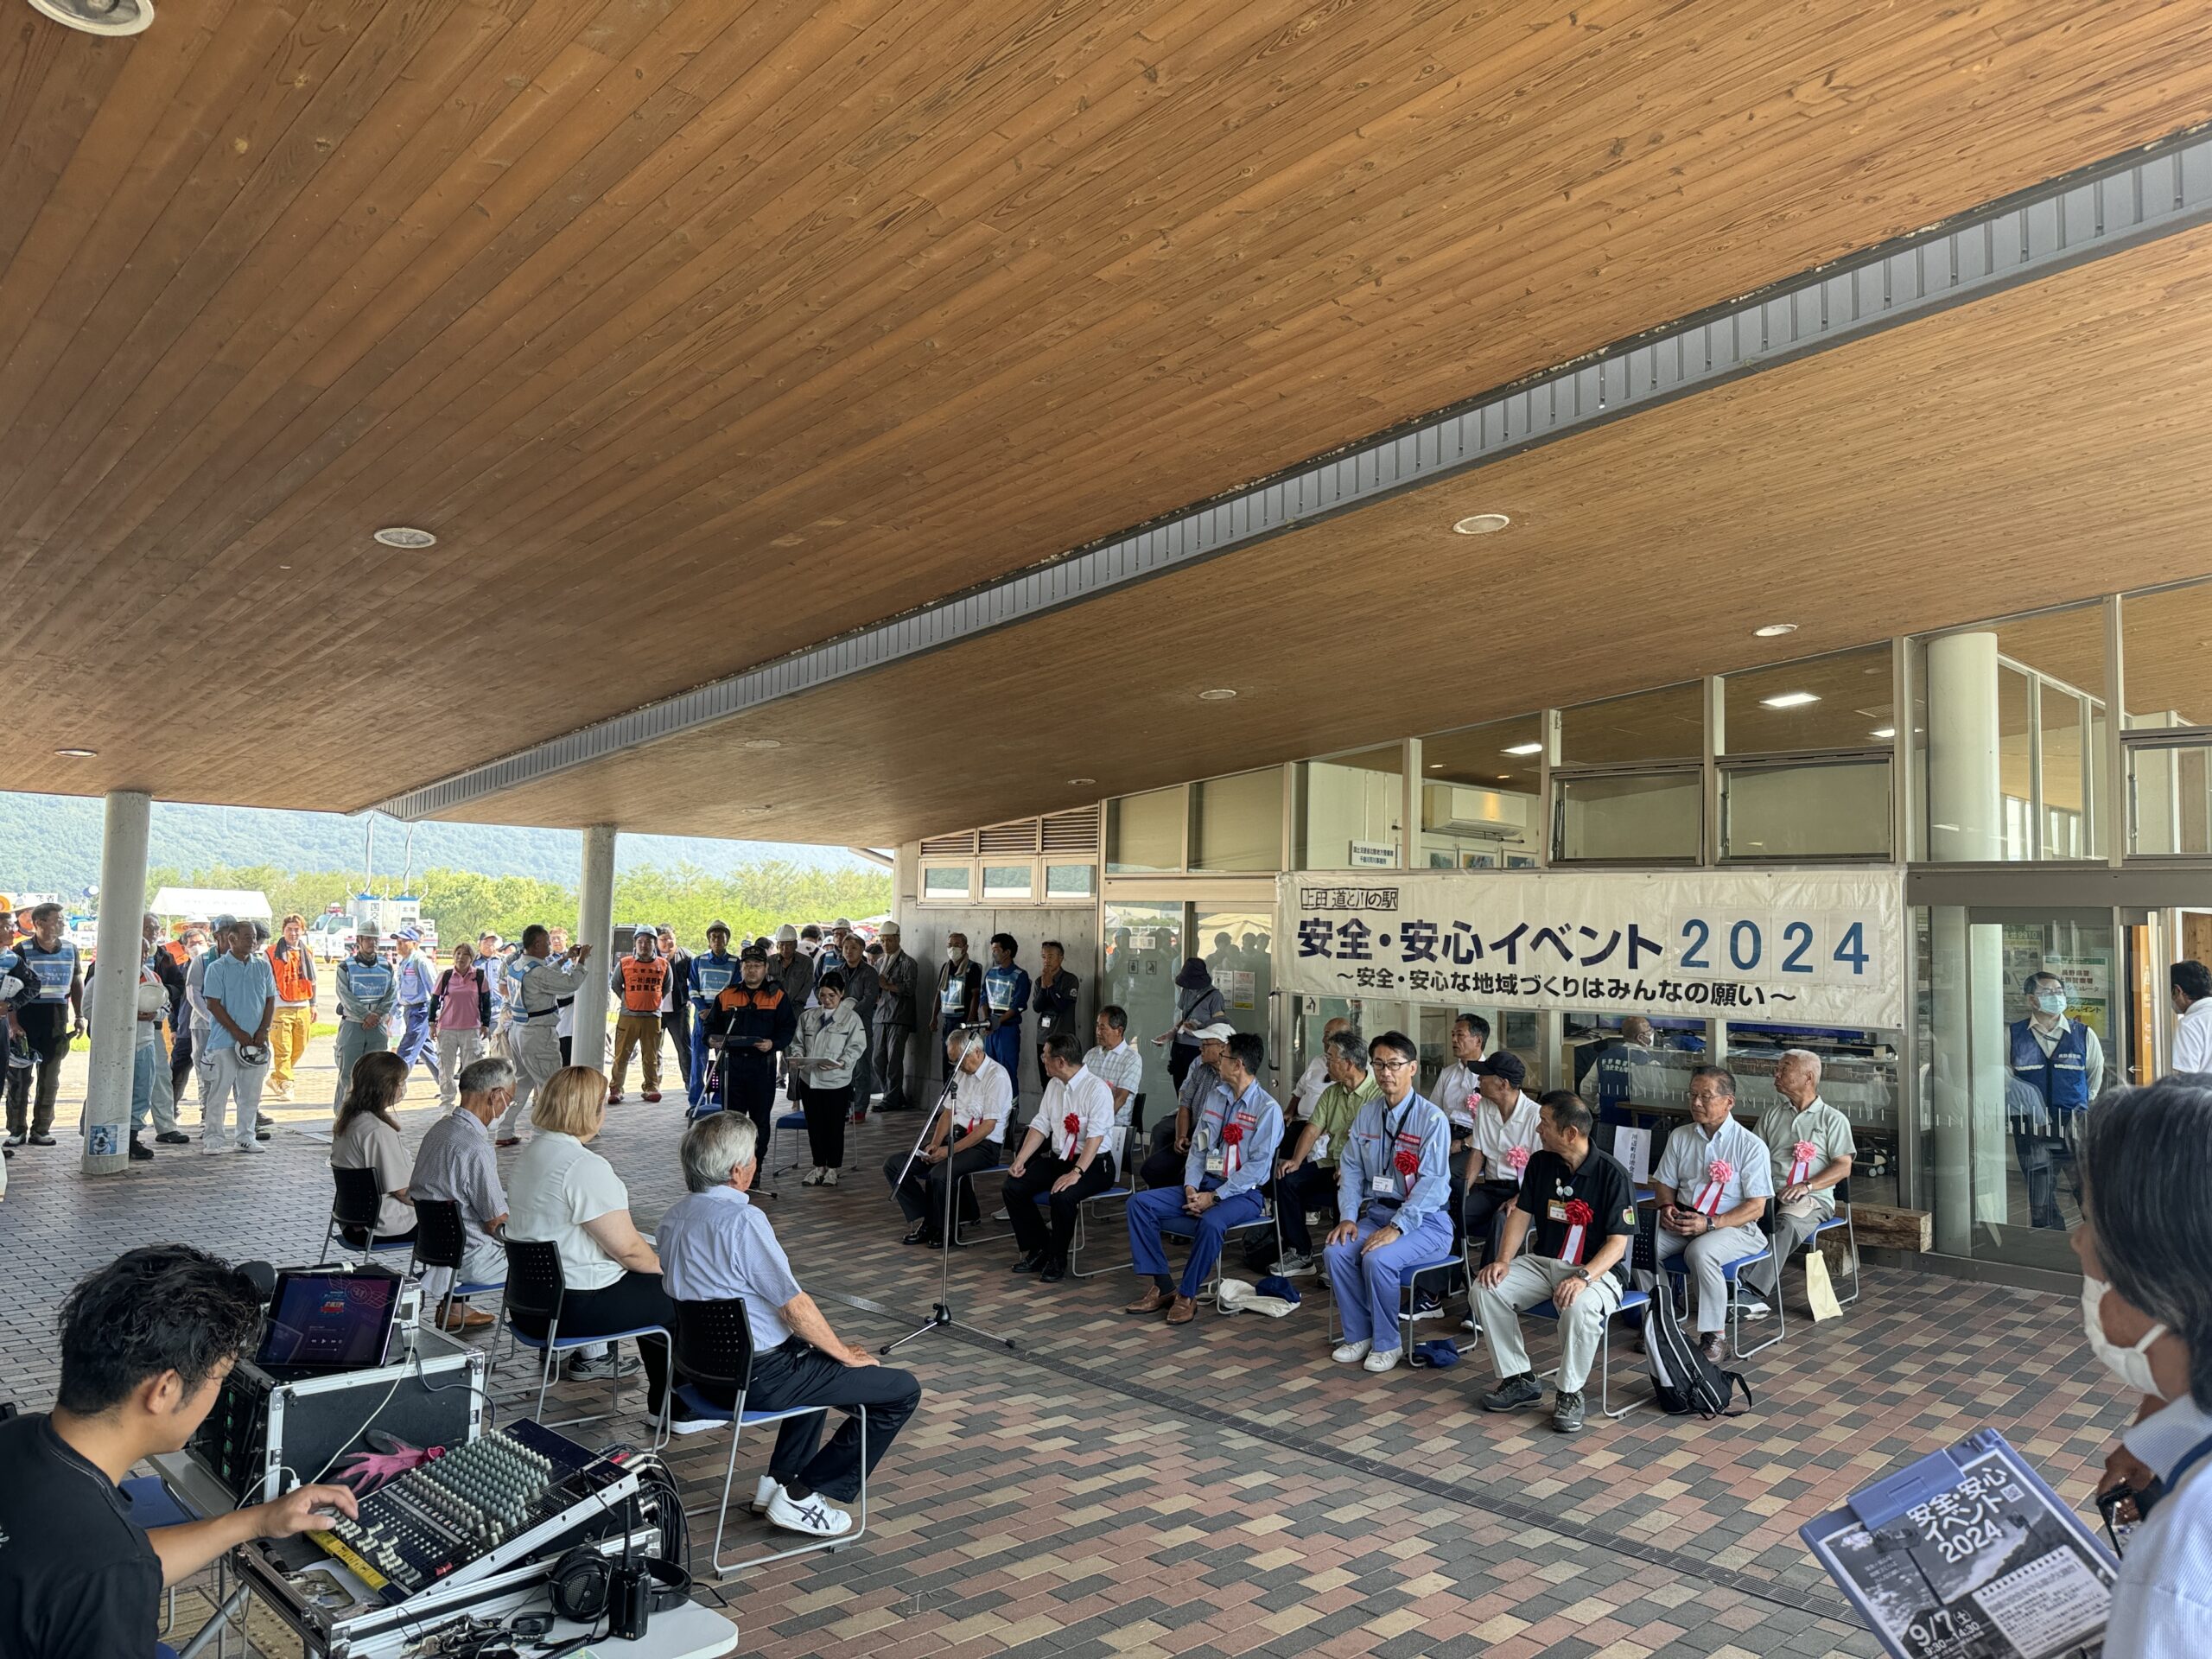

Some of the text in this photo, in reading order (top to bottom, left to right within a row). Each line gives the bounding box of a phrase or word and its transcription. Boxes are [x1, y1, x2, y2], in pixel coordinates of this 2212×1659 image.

[1301, 890, 1397, 908] 上田 道と川の駅
[1298, 918, 1870, 975] 安全・安心イベント 2024
[1906, 1467, 2007, 1528] 安全・安心
[1924, 1494, 2003, 1542] イベント
[1937, 1518, 2003, 1563] 2024
